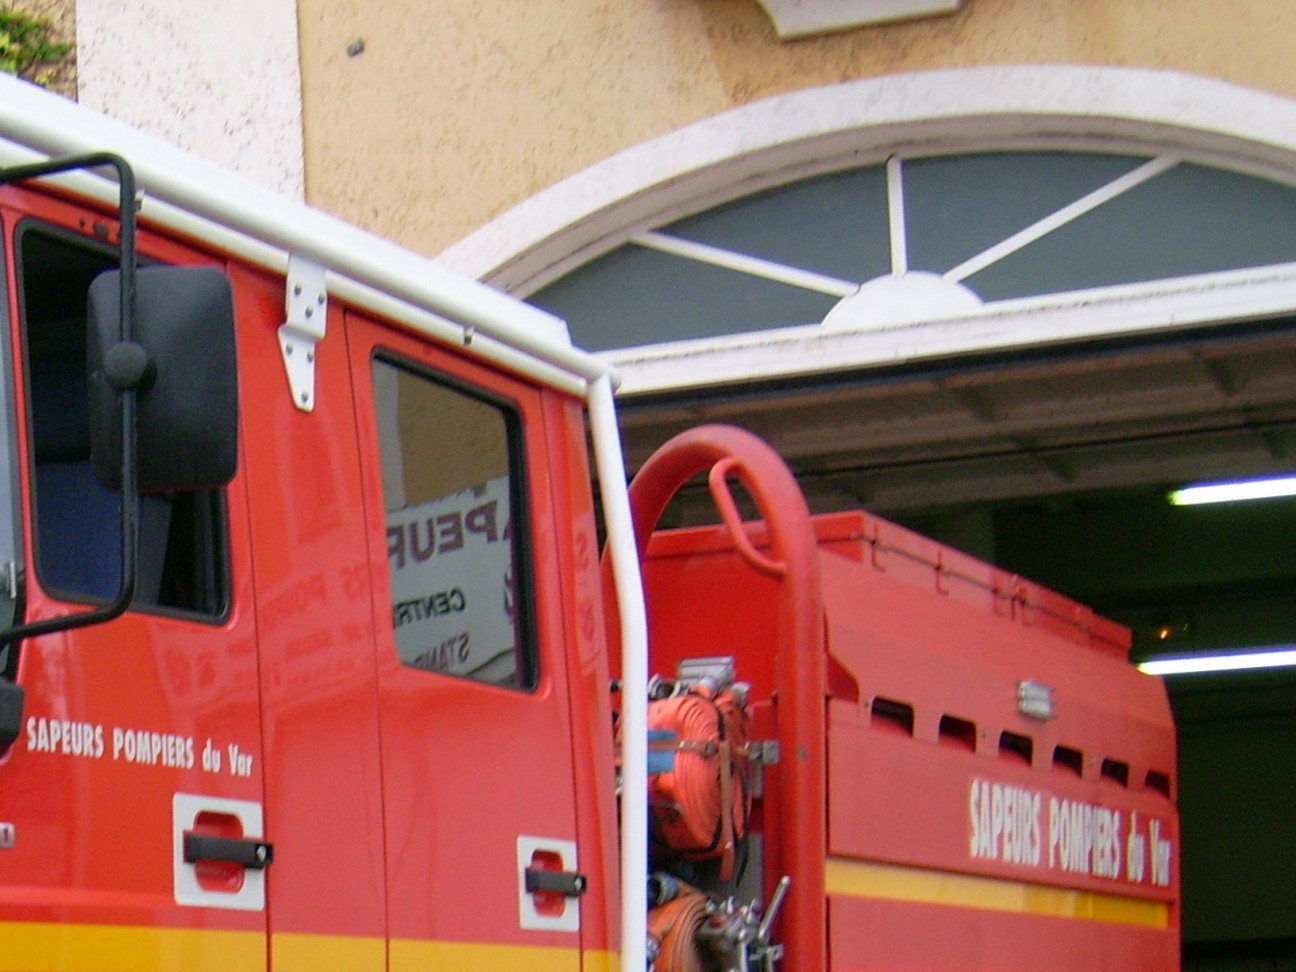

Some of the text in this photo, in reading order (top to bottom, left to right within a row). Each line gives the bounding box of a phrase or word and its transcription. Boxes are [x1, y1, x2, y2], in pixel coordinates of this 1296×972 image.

[27, 716, 253, 777] SAPEURS POMPIERS du Var
[970, 778, 1040, 868] SAPEURS
[1049, 797, 1120, 880] POMPIERS
[1127, 811, 1144, 883] du
